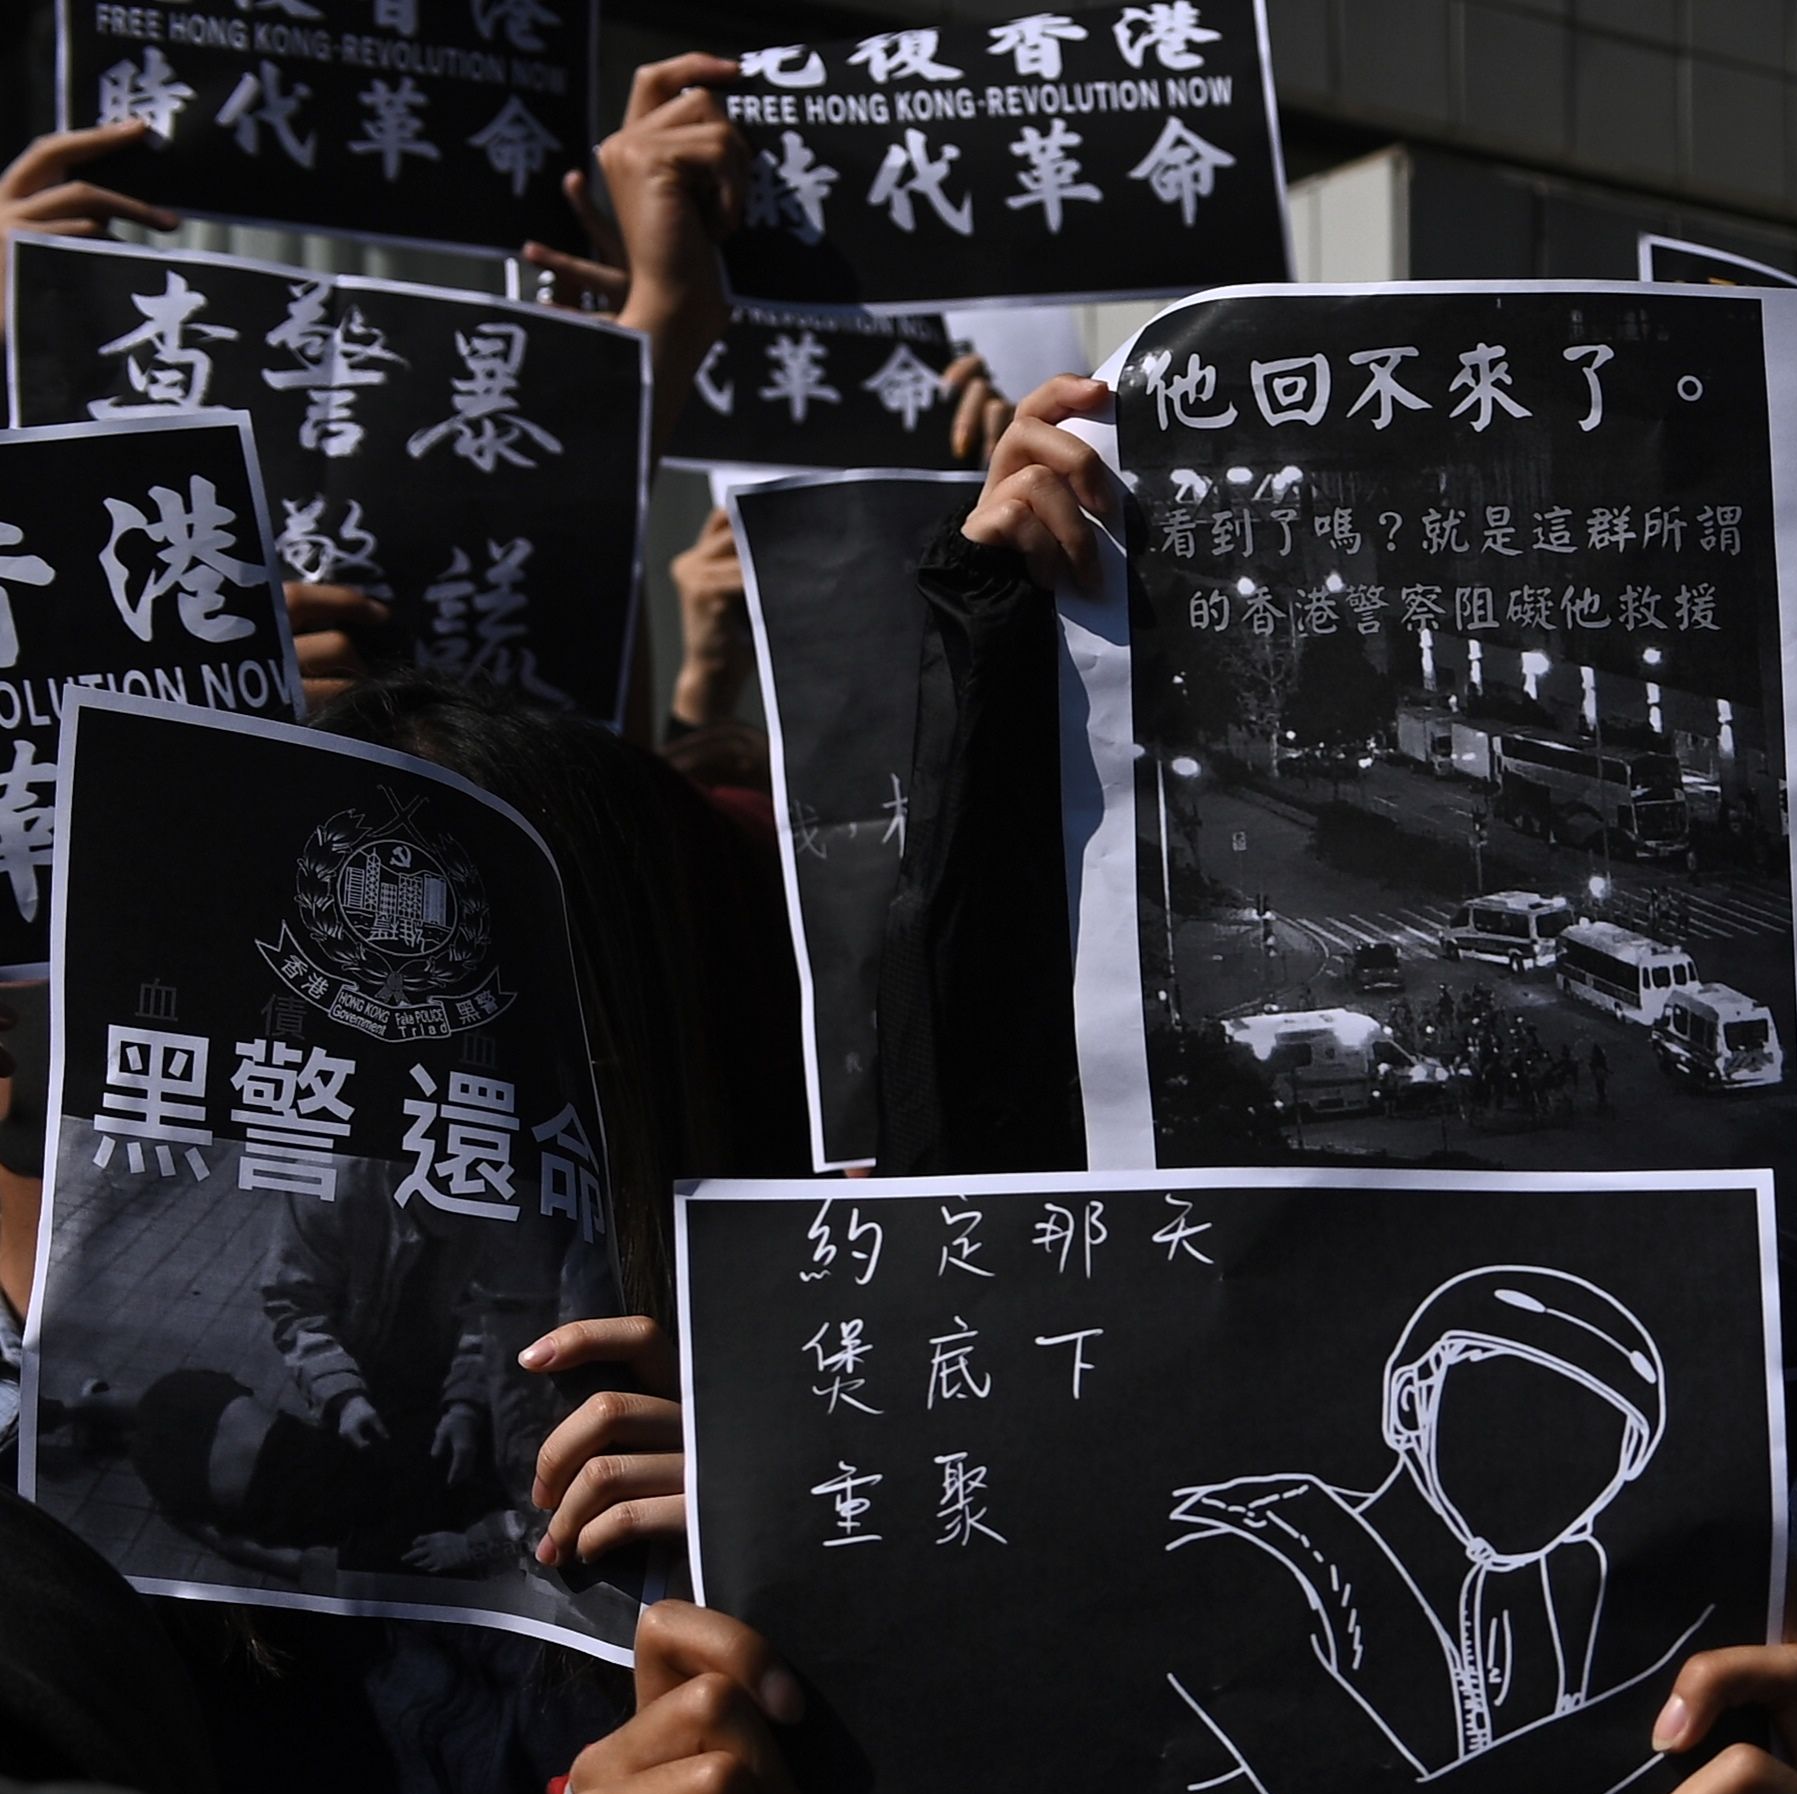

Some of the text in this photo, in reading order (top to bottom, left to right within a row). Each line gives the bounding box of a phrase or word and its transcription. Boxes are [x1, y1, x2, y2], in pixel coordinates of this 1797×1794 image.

[98, 4, 162, 40] FREE
[168, 16, 249, 51] HONG
[98, 46, 563, 197] 時代革命
[727, 94, 798, 125] FREE
[805, 92, 888, 124] HONG
[1165, 75, 1233, 107] NOW
[743, 116, 1237, 246] 時代革命
[87, 270, 566, 472] 查警暴
[1145, 342, 1704, 433] 他回不來了。
[1188, 582, 1722, 637] 的香港警察阻礙他救援
[281, 954, 330, 1001] 香港
[456, 989, 499, 1026] 黑警
[92, 1022, 608, 1246] 黑警還命
[800, 1192, 1214, 1286] 約定那天
[808, 1450, 1009, 1548] 重聚
